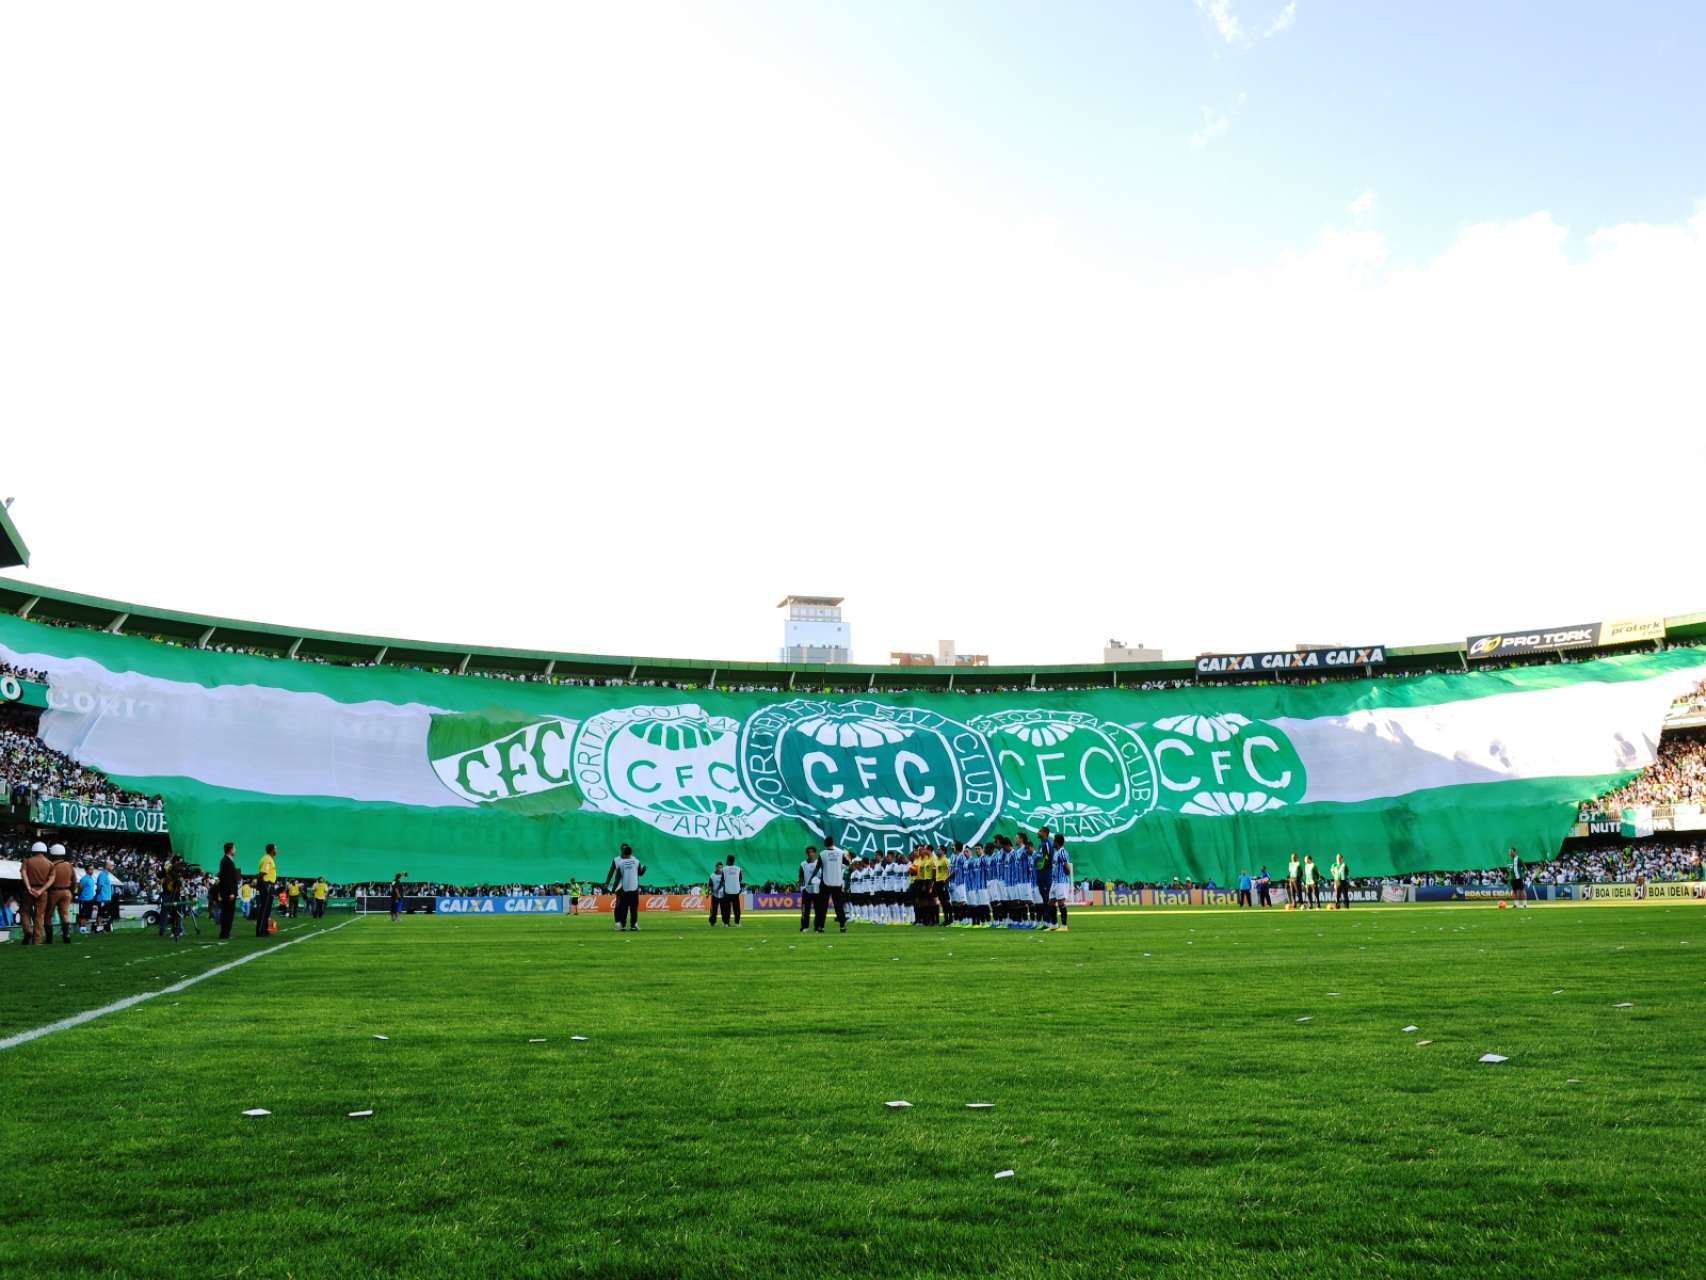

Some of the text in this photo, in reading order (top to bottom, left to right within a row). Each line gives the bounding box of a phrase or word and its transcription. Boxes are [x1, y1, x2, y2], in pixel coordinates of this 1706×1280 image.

[1502, 635, 1539, 648] PRO
[1543, 628, 1593, 643] TORK
[1198, 648, 1384, 672] CAIXA CAIXA CAIXA
[455, 720, 571, 800] CFC
[953, 731, 993, 806] CLUB
[999, 746, 1121, 802] CFC
[1121, 742, 1152, 801] CLUB
[1154, 735, 1292, 793] CFC
[626, 759, 741, 794] CFC
[802, 750, 937, 804] CFC
[60, 802, 129, 831] TORCIDA
[135, 810, 169, 833] QUE
[439, 898, 558, 913] CAIXA CAIXA
[646, 896, 670, 909] GOL
[681, 896, 705, 909] GOL
[758, 896, 794, 908] VIVO
[1105, 890, 1239, 906] Itaú Itaú Itaú
[1595, 887, 1610, 897] BOA
[1612, 886, 1631, 897] IDEIA
[1648, 886, 1665, 897] BOA
[1667, 885, 1690, 897] IDEIA
